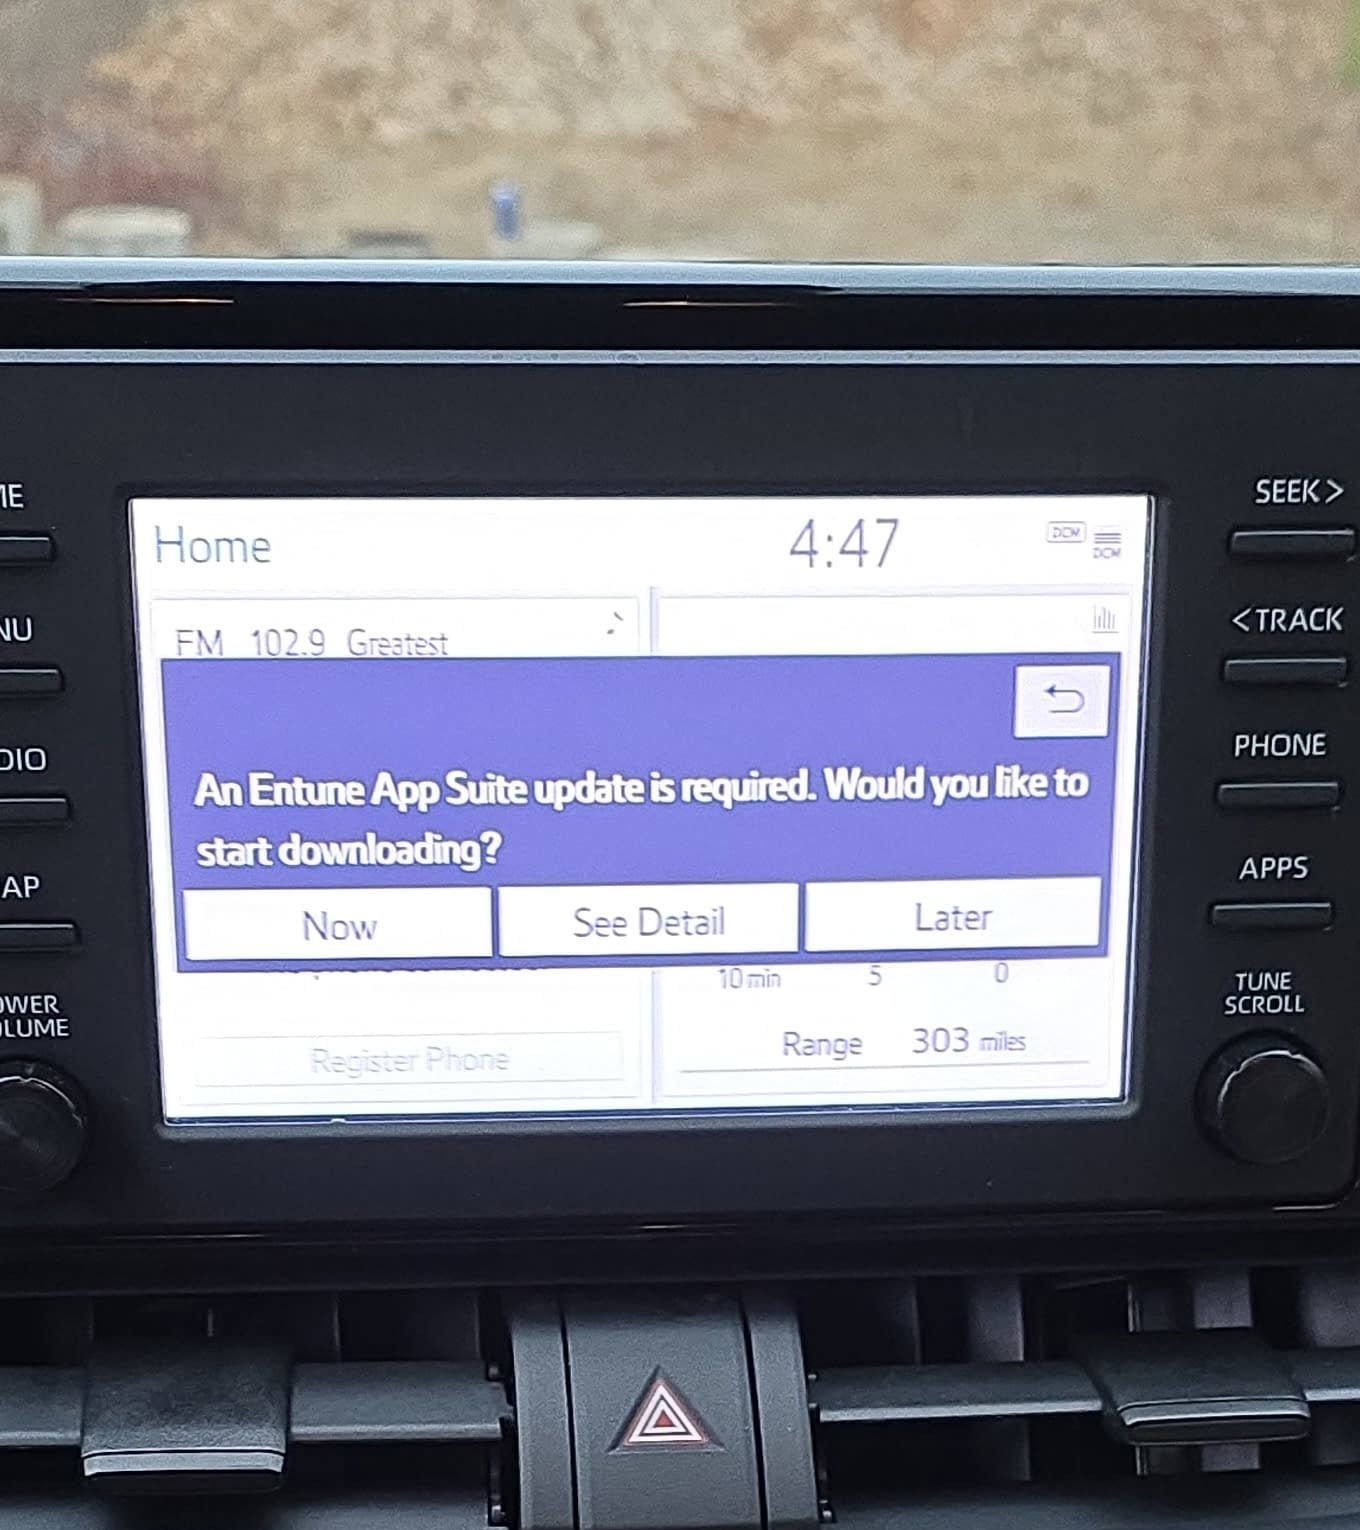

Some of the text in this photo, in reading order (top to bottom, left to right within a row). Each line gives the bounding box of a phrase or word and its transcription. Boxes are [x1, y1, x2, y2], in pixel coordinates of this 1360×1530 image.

[155, 525, 271, 564] Home
[789, 518, 899, 569] 4:47
[175, 628, 449, 657] FM 102.9 Greatest
[1234, 733, 1326, 757] PHONE
[193, 764, 1089, 813] An Entune App Suite update is required. Would you like to
[197, 830, 502, 872] start downloading?
[1239, 855, 1308, 880] APPS
[303, 910, 377, 941] Now
[573, 906, 724, 938] See Detail
[916, 902, 993, 932] Later
[868, 966, 882, 987] 5
[1235, 971, 1292, 991] TUNE
[1224, 994, 1305, 1015] SCROLL
[783, 1026, 1026, 1061] Range 303 miles
[311, 1045, 510, 1079] Register Phone
